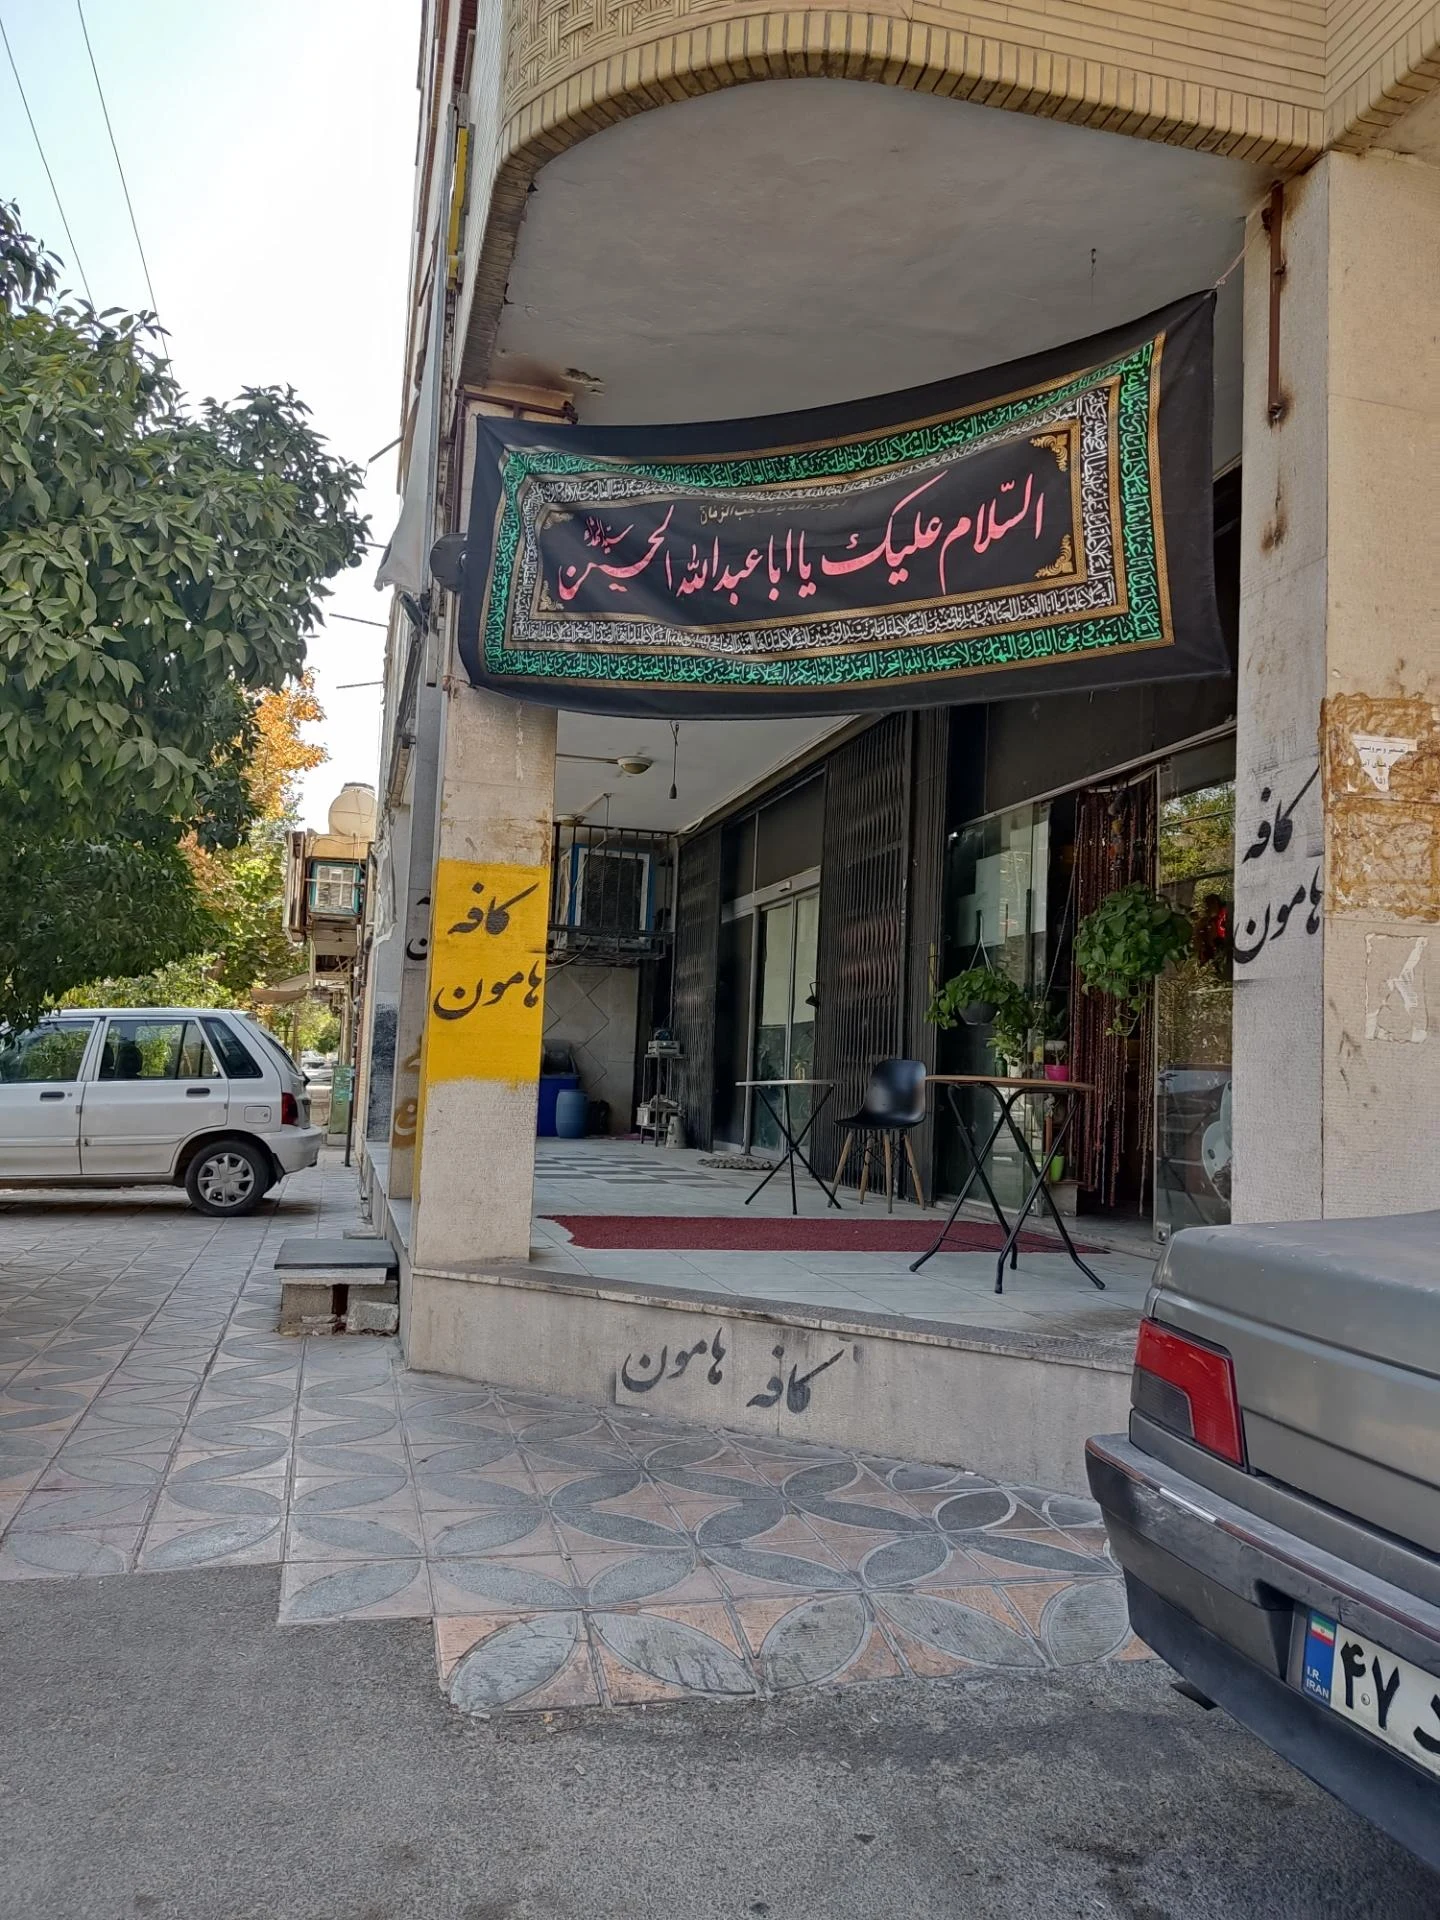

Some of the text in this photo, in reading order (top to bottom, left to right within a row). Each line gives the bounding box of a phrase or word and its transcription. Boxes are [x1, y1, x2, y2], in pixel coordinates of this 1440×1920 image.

[1242, 765, 1320, 864] کافه
[448, 882, 540, 935] کافه
[1233, 866, 1323, 964] هامون
[433, 960, 543, 1020] هامون
[621, 1326, 845, 1414] کافه هامون
[1306, 1678, 1330, 1700] IRAN
